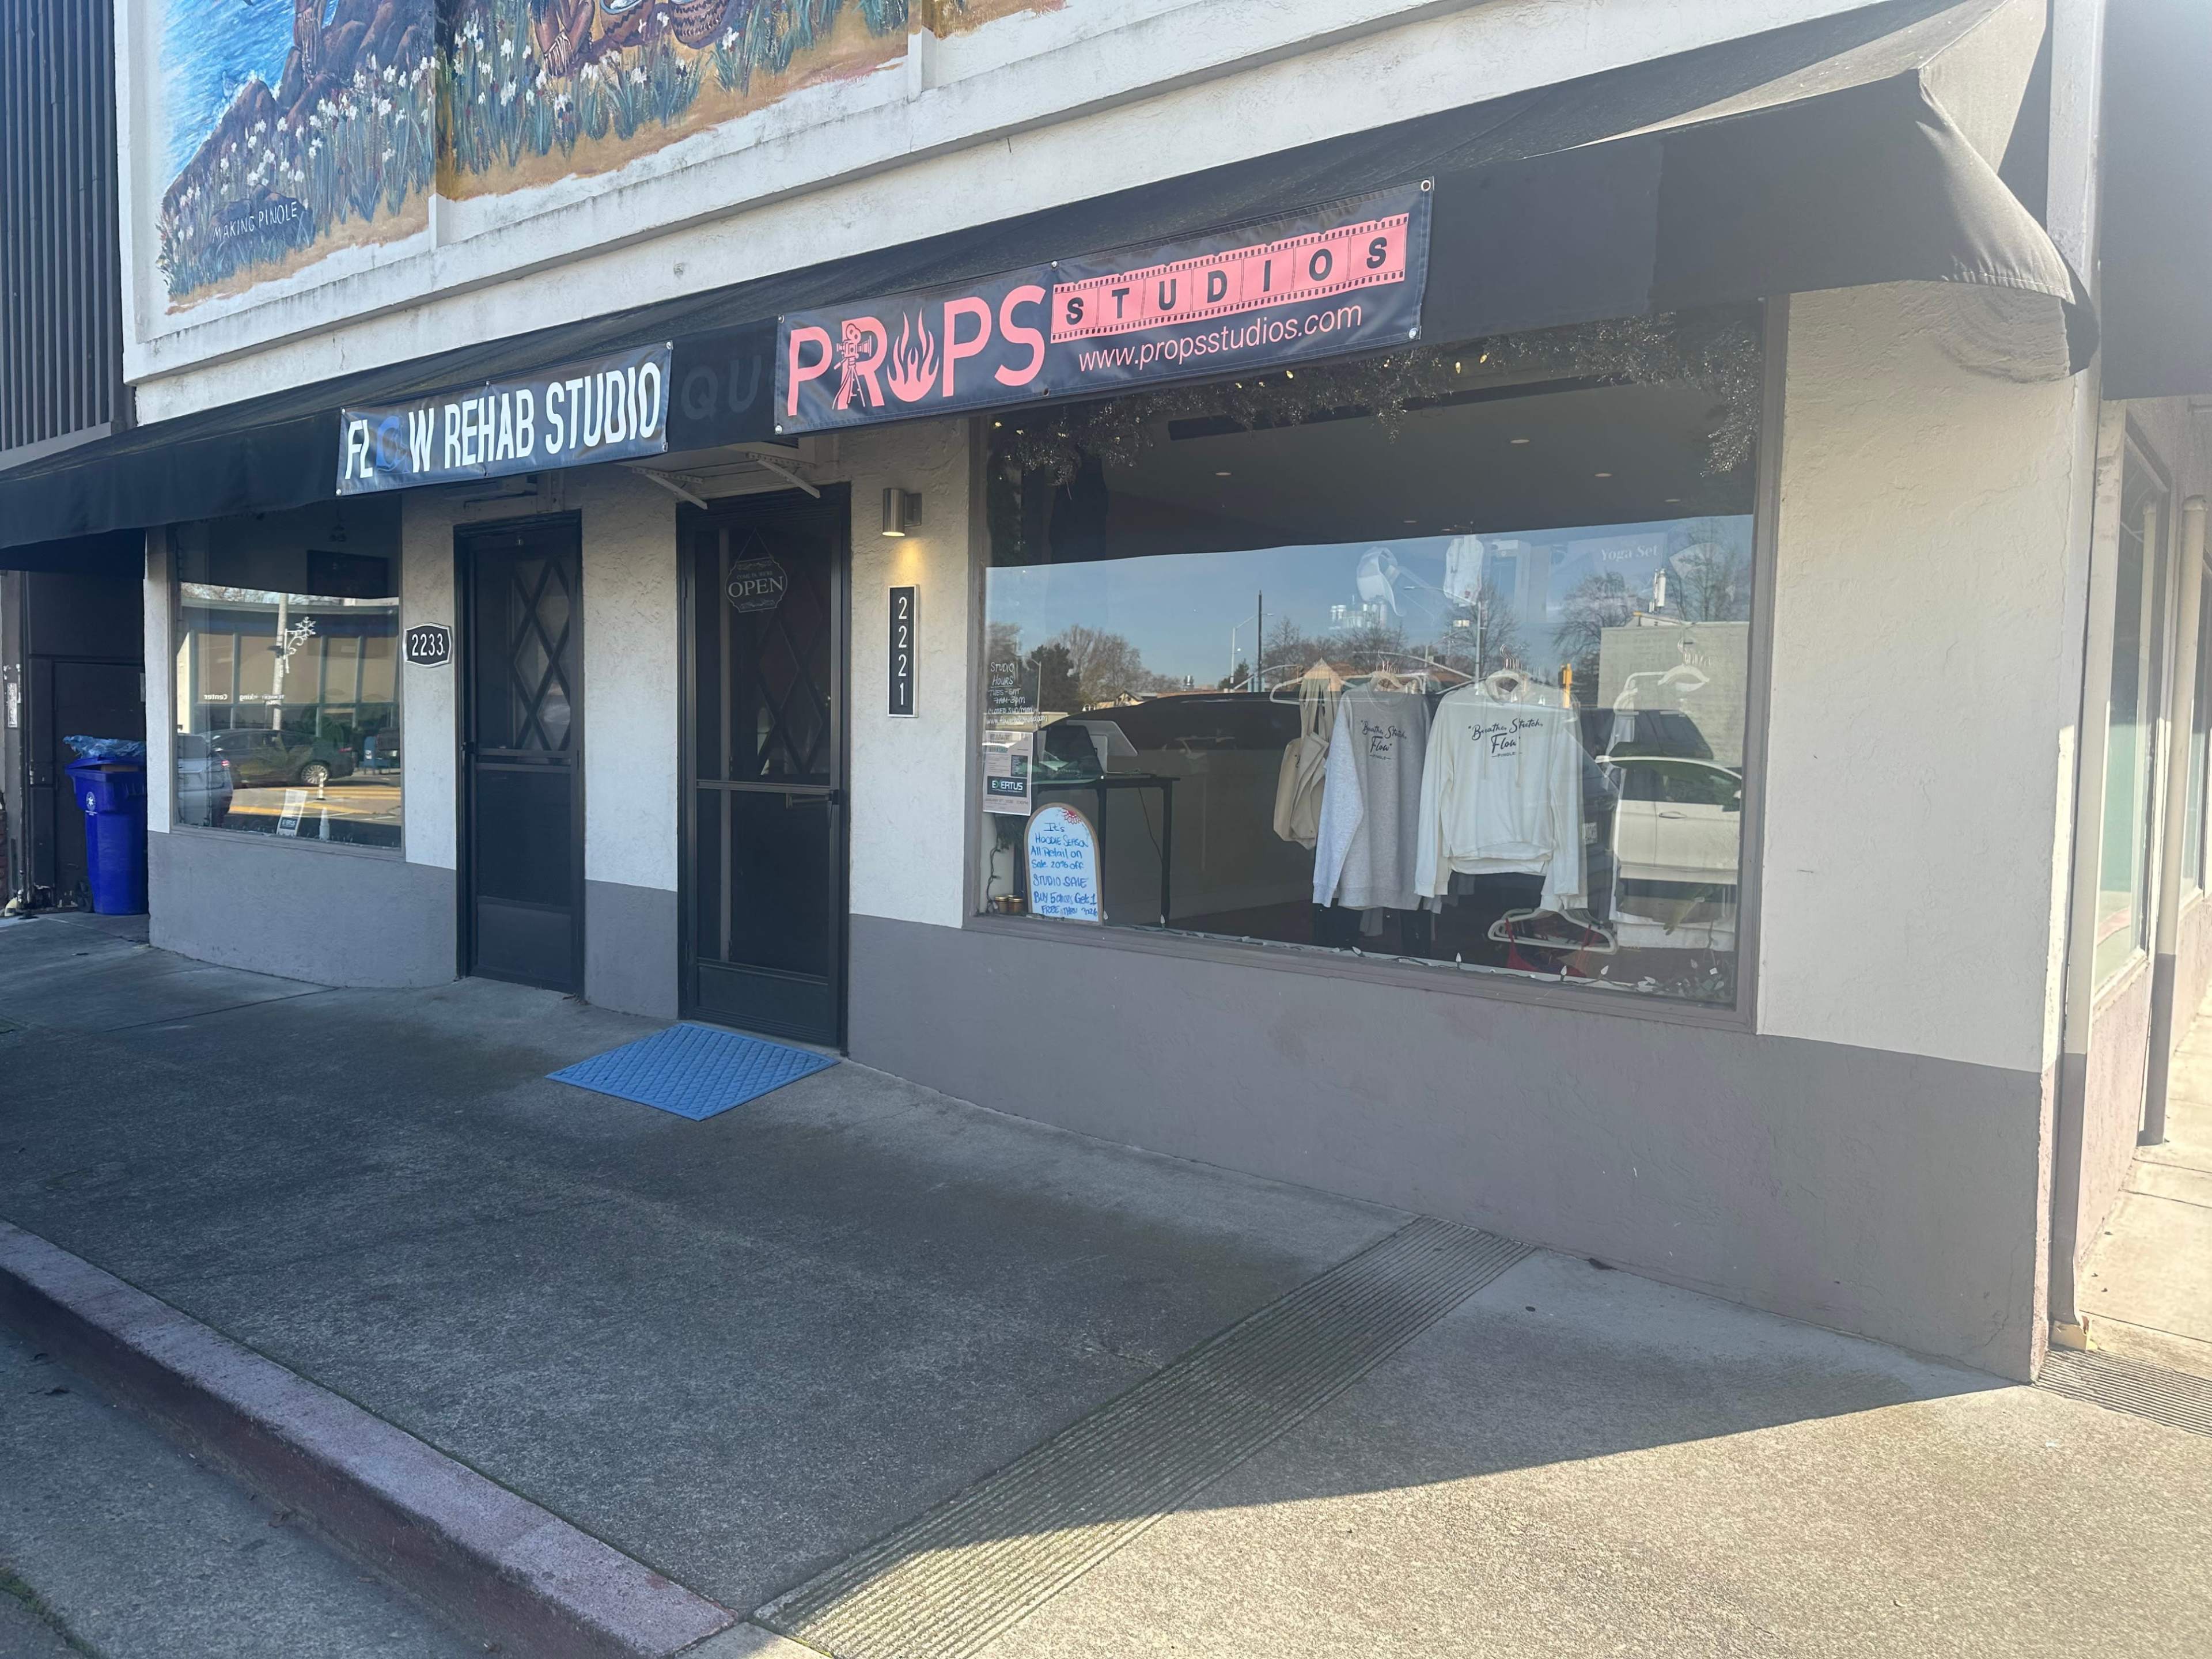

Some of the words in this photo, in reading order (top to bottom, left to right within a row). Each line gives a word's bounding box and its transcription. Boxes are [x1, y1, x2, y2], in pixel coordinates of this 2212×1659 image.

[213, 216, 255, 243] MAKING
[259, 202, 297, 228] PINOLE
[1066, 237, 1387, 325] STUDIOS
[1079, 305, 1362, 372] www.propsstudios.com
[444, 389, 535, 469] REHAB
[546, 362, 661, 454] STUDIO
[1601, 548, 1633, 562] Yoga
[1636, 544, 1660, 557] Set
[728, 576, 783, 597] OPEN
[412, 633, 444, 656] 2233
[898, 597, 907, 706] 2221
[991, 662, 1014, 673] STUDIO
[992, 675, 1014, 686] HOURS
[1044, 823, 1065, 832] It's
[1035, 833, 1061, 846] HOODIE
[1031, 846, 1041, 857] All
[1041, 847, 1069, 859] Retail
[1070, 850, 1082, 859] on
[1031, 859, 1048, 869] Sale
[1051, 861, 1069, 869] 20%
[1070, 861, 1084, 870] off
[1033, 873, 1061, 887] STUDIO
[1063, 876, 1089, 888] SALE
[1033, 891, 1048, 904] BUY
[1041, 905, 1060, 914] FREE
